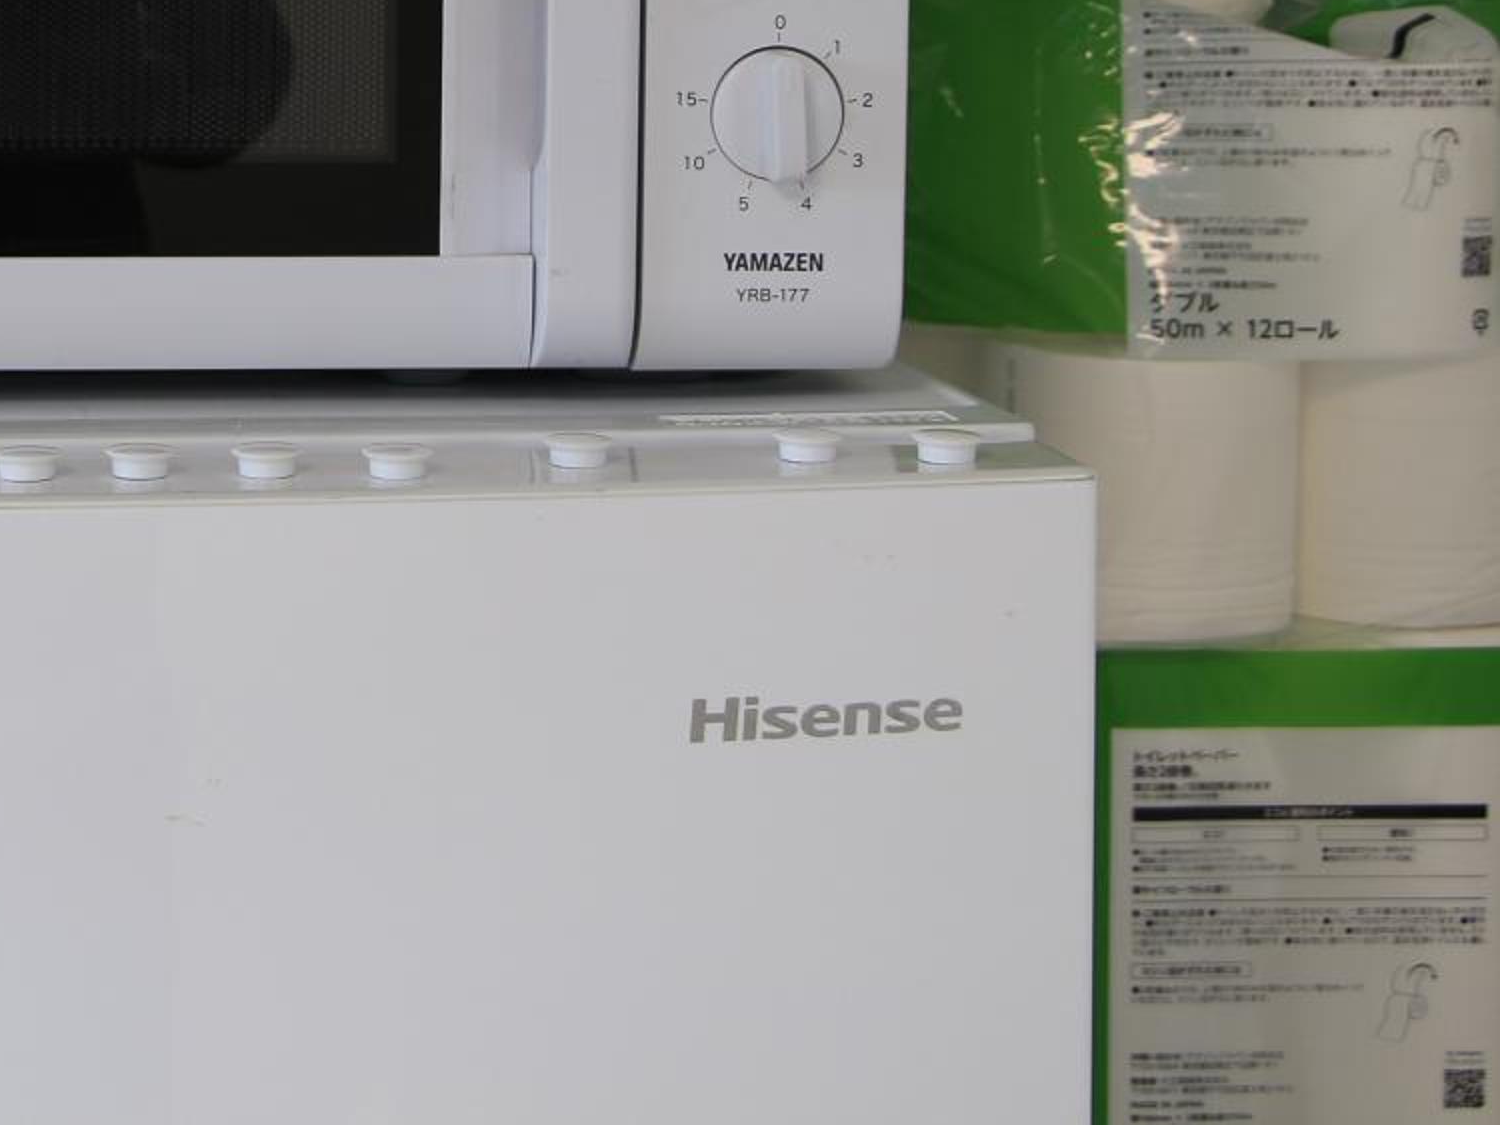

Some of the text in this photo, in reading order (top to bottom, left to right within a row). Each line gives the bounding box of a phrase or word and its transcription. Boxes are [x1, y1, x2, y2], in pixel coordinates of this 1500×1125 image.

[774, 14, 787, 30] 0
[833, 40, 841, 54] 1
[676, 92, 697, 107] 15
[862, 92, 873, 108] 2
[683, 156, 705, 171] 10
[852, 153, 864, 168] 3
[739, 196, 749, 212] 5
[800, 196, 812, 211] 4
[723, 252, 824, 272] YAMAZEN
[736, 288, 810, 303] YRB-177
[1150, 318, 1204, 339] 50m
[1248, 318, 1340, 339] 12ロール
[689, 696, 963, 744] Hisense
